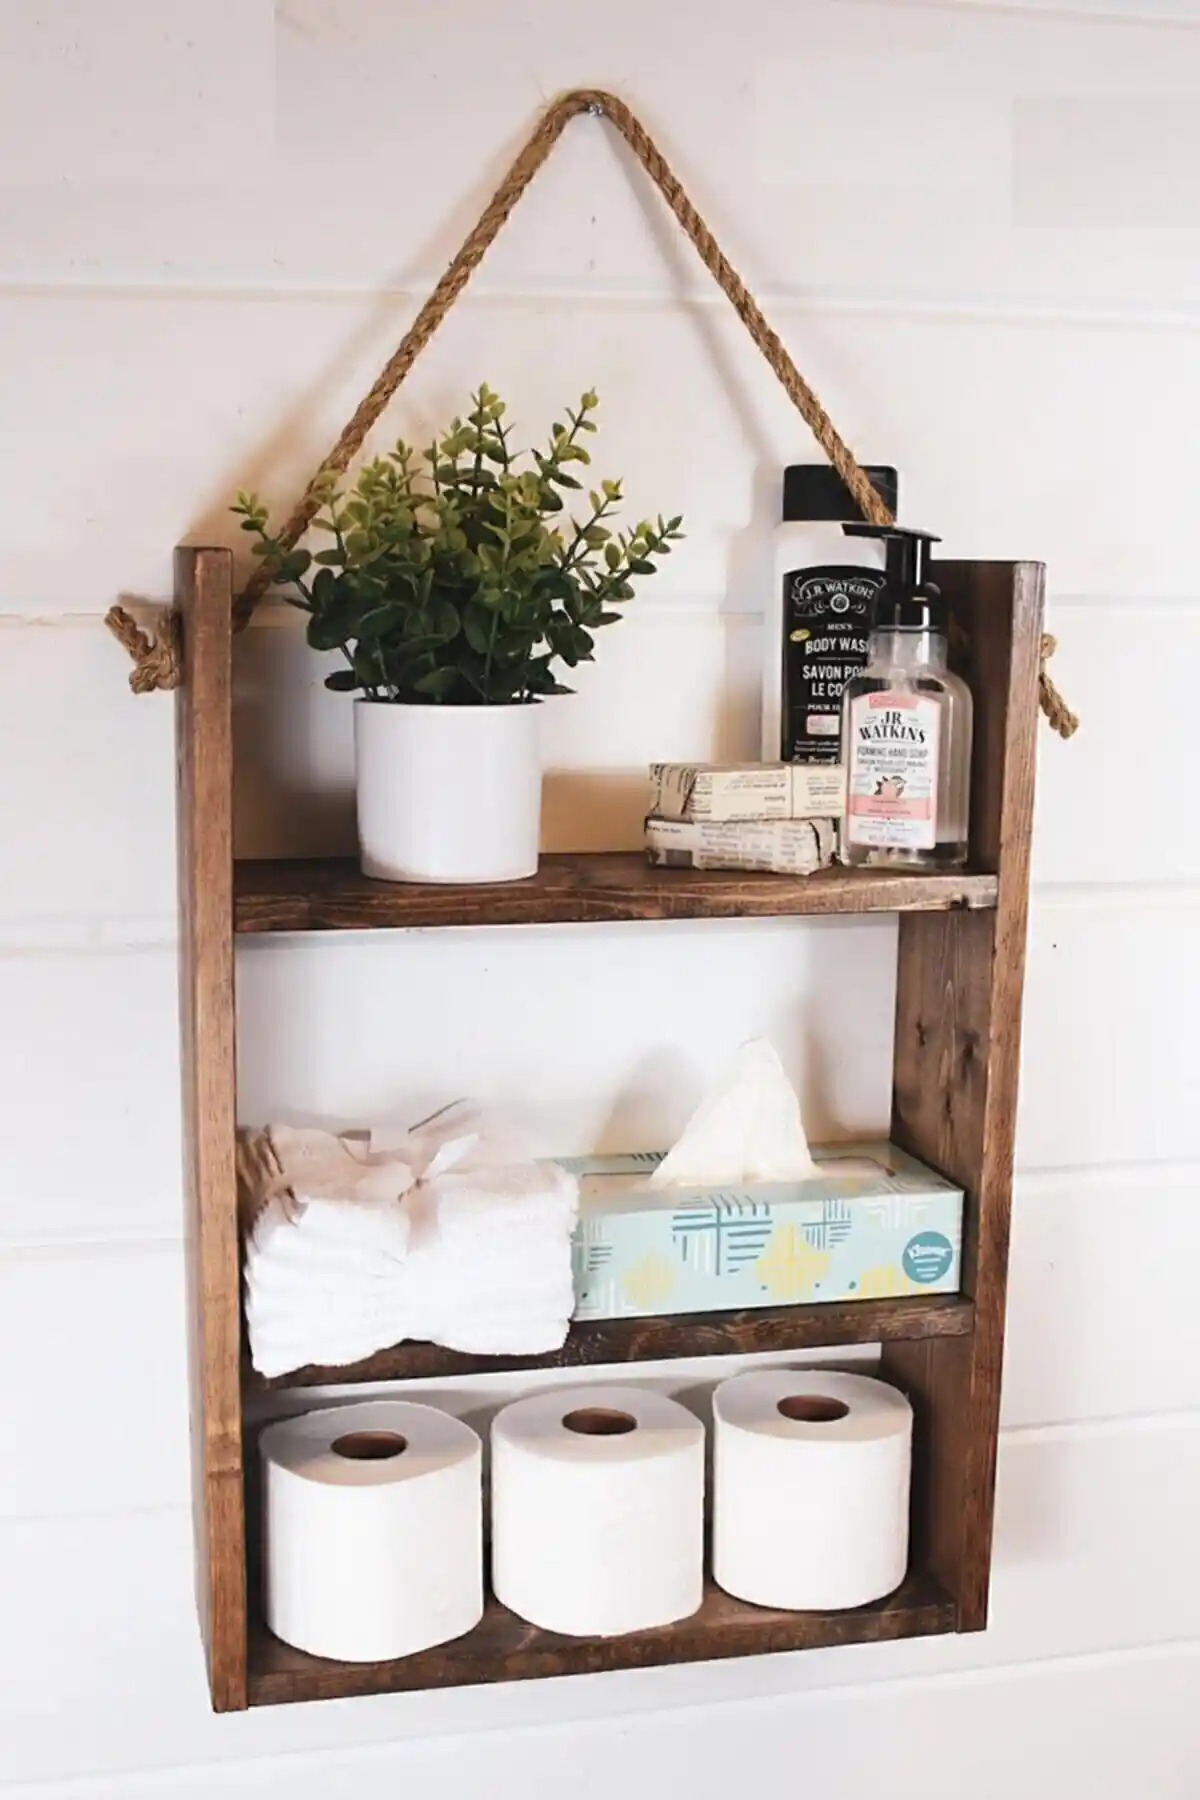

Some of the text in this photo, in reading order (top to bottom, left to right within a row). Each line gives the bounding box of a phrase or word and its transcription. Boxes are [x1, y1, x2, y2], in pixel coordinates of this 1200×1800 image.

[825, 582, 875, 600] WATKINS
[826, 623, 853, 631] MEN'S
[804, 638, 837, 655] BODY
[802, 665, 867, 680] SAVON PO
[811, 682, 844, 697] LE CO
[859, 725, 926, 743] WATKINS
